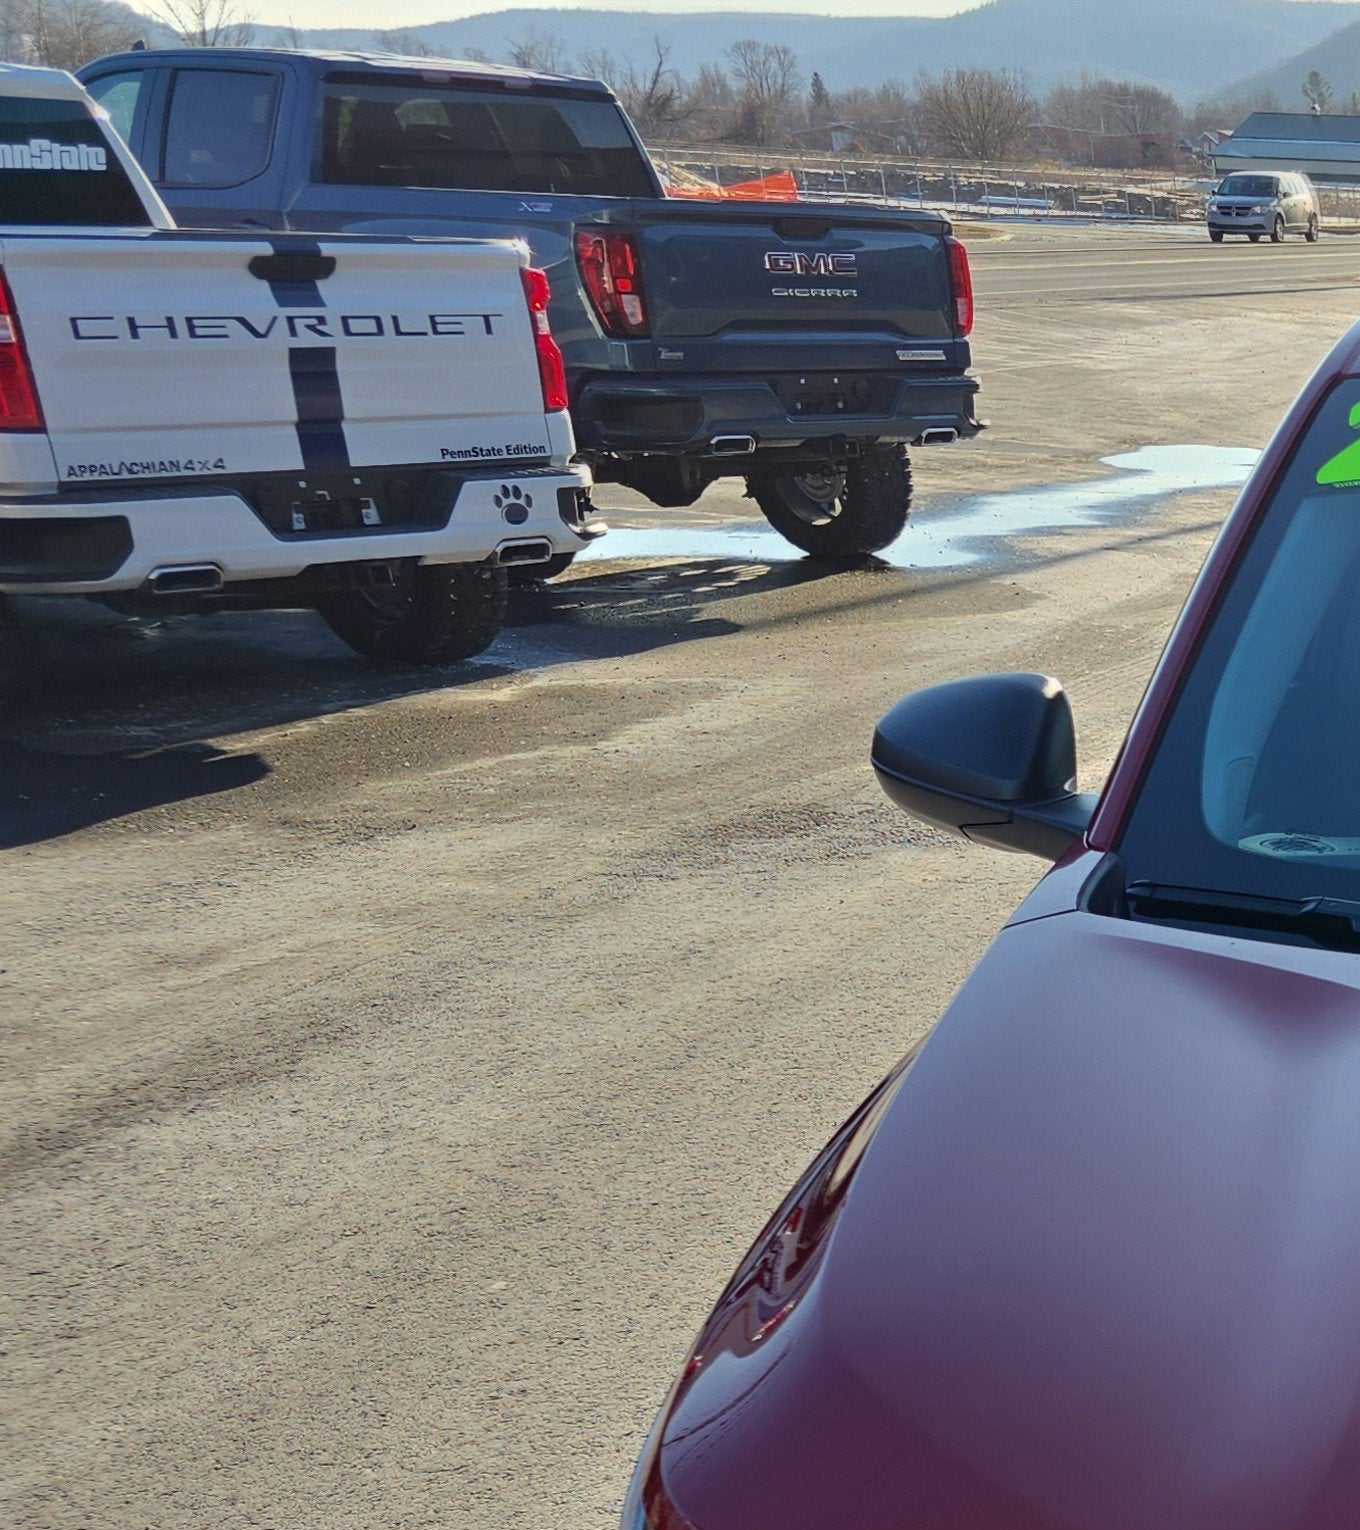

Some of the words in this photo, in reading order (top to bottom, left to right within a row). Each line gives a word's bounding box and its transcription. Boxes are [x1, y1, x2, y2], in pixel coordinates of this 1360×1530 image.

[765, 251, 858, 275] GMC
[771, 288, 858, 297] SIERRA
[69, 313, 503, 340] CHEVROLET
[440, 446, 504, 459] PennState
[505, 443, 546, 456] Edition
[67, 459, 181, 478] APPALACHIAN
